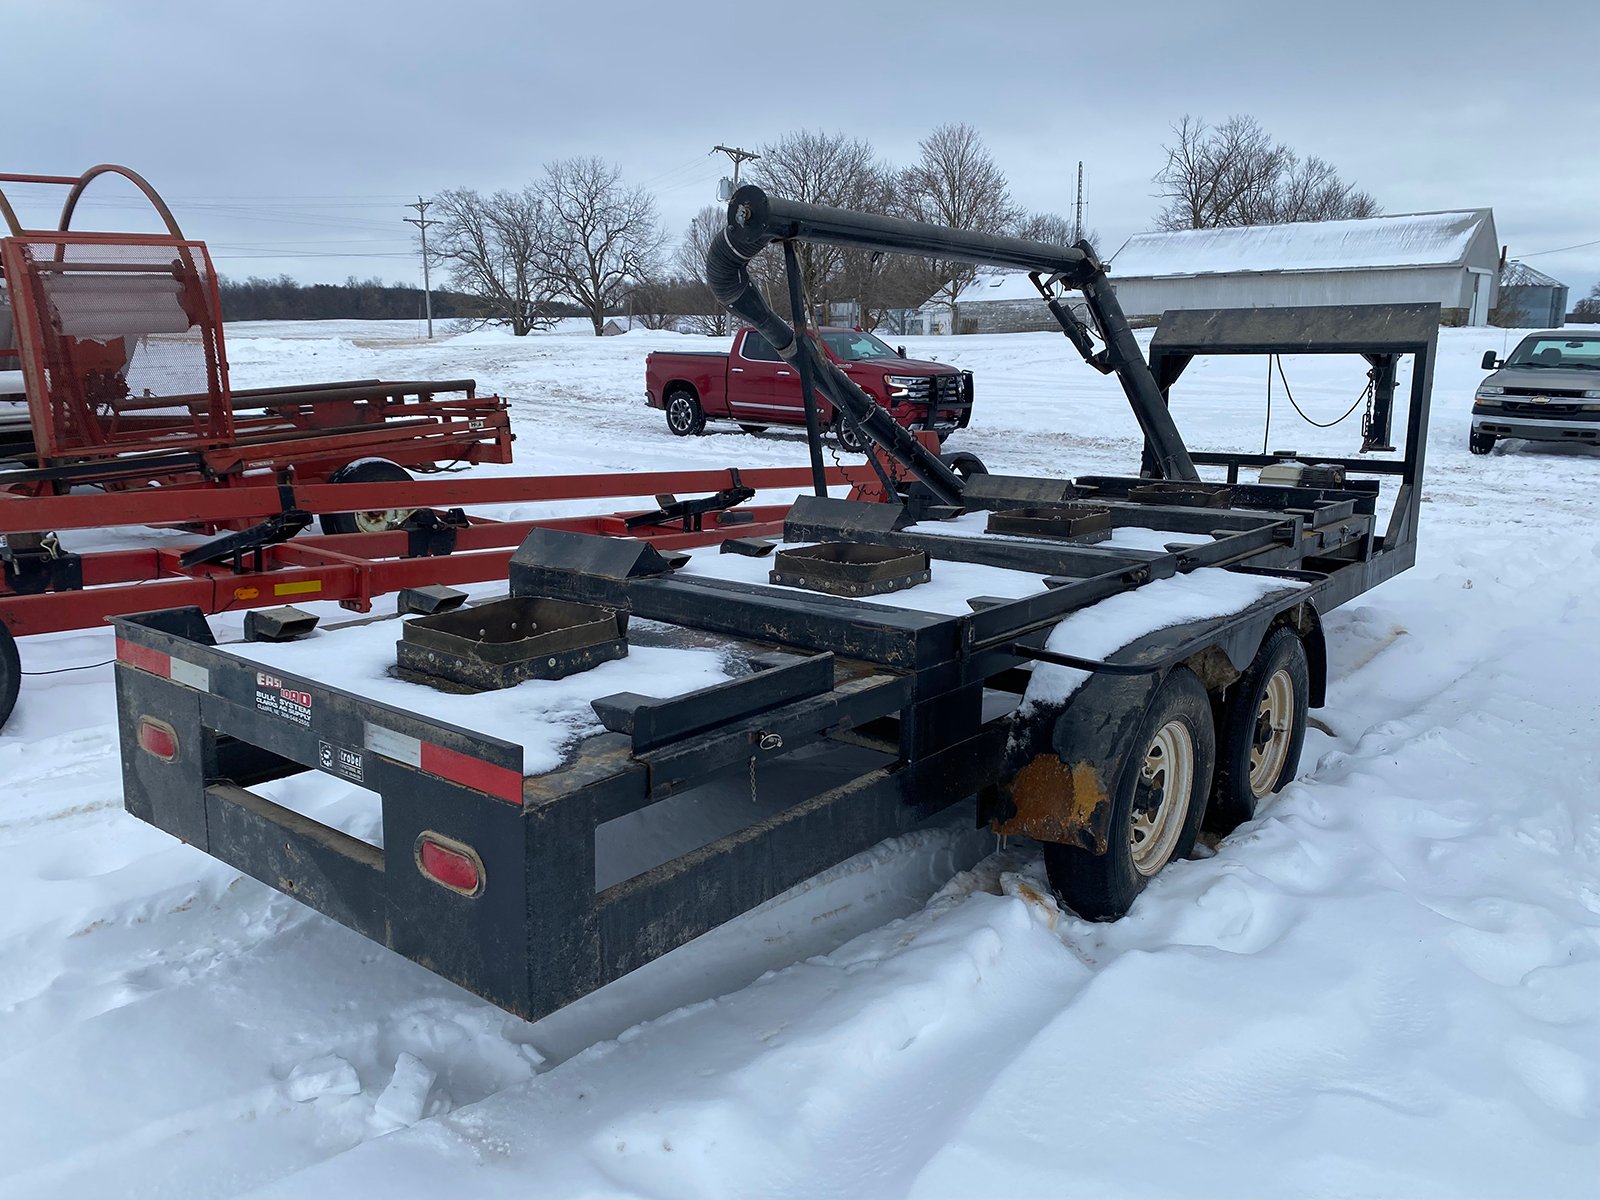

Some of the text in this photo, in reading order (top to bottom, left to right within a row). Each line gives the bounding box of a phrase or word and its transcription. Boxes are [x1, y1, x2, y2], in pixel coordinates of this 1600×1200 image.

[256, 672, 282, 688] EASI
[256, 691, 311, 715] BULK SYSTEM
[256, 697, 278, 709] CLARKS
[288, 708, 311, 721] SUPPLY
[280, 688, 312, 708] LOAD
